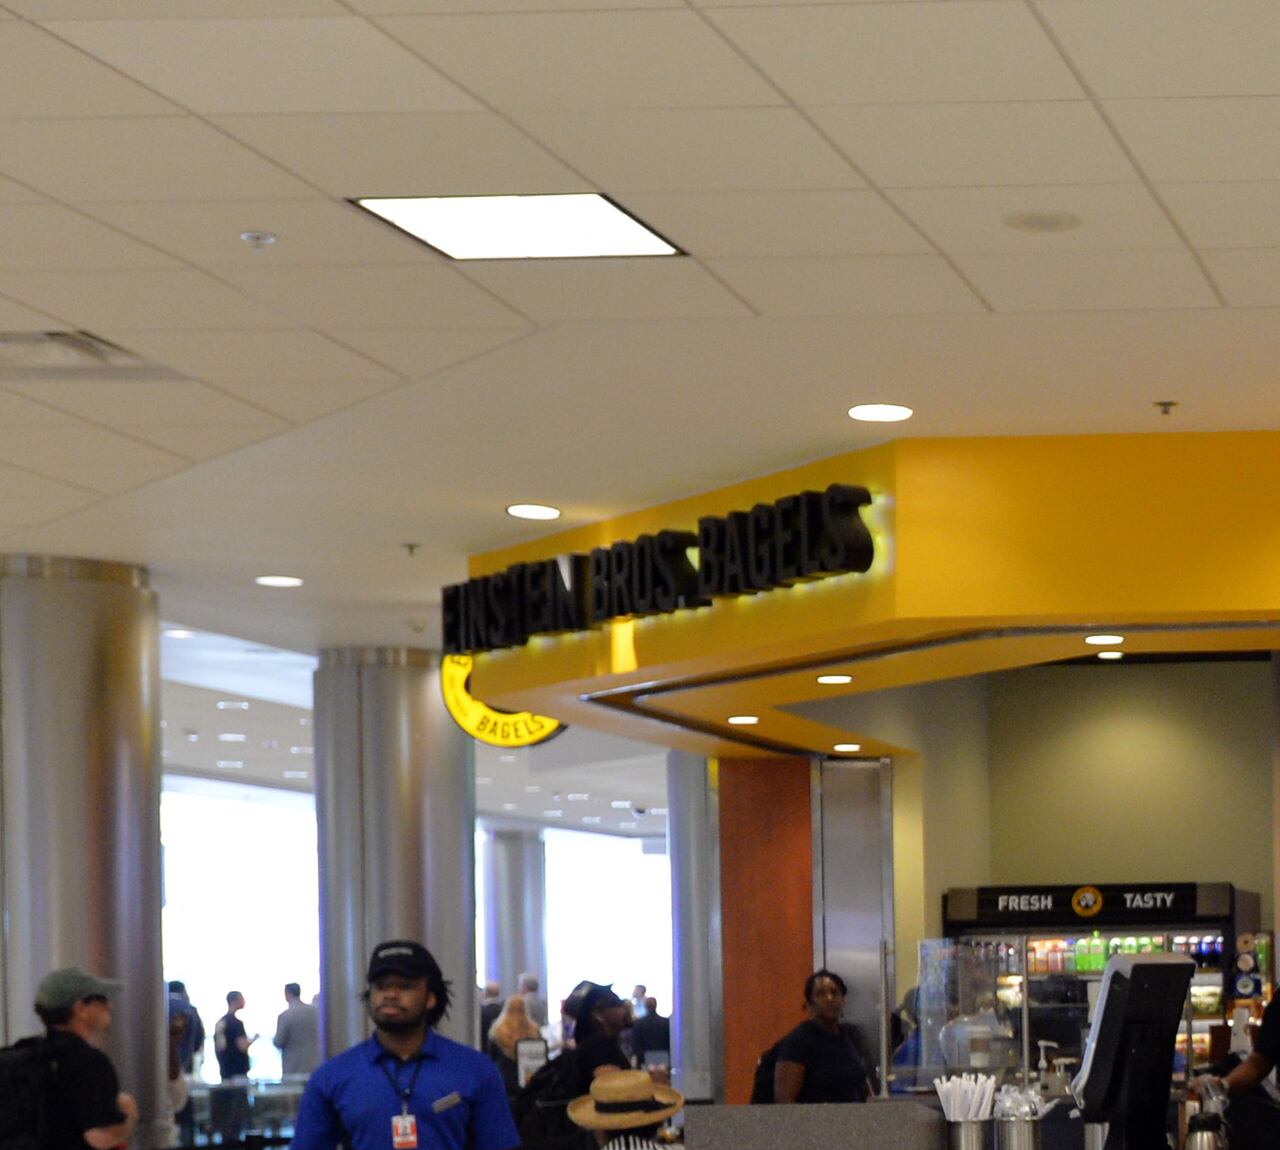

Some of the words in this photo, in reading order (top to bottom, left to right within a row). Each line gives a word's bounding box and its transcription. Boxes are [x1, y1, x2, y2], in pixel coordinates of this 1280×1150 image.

[698, 484, 873, 597] BAGELS
[476, 714, 546, 739] BAGELS
[997, 894, 1053, 911] FRESH
[1123, 892, 1175, 908] TASTY
